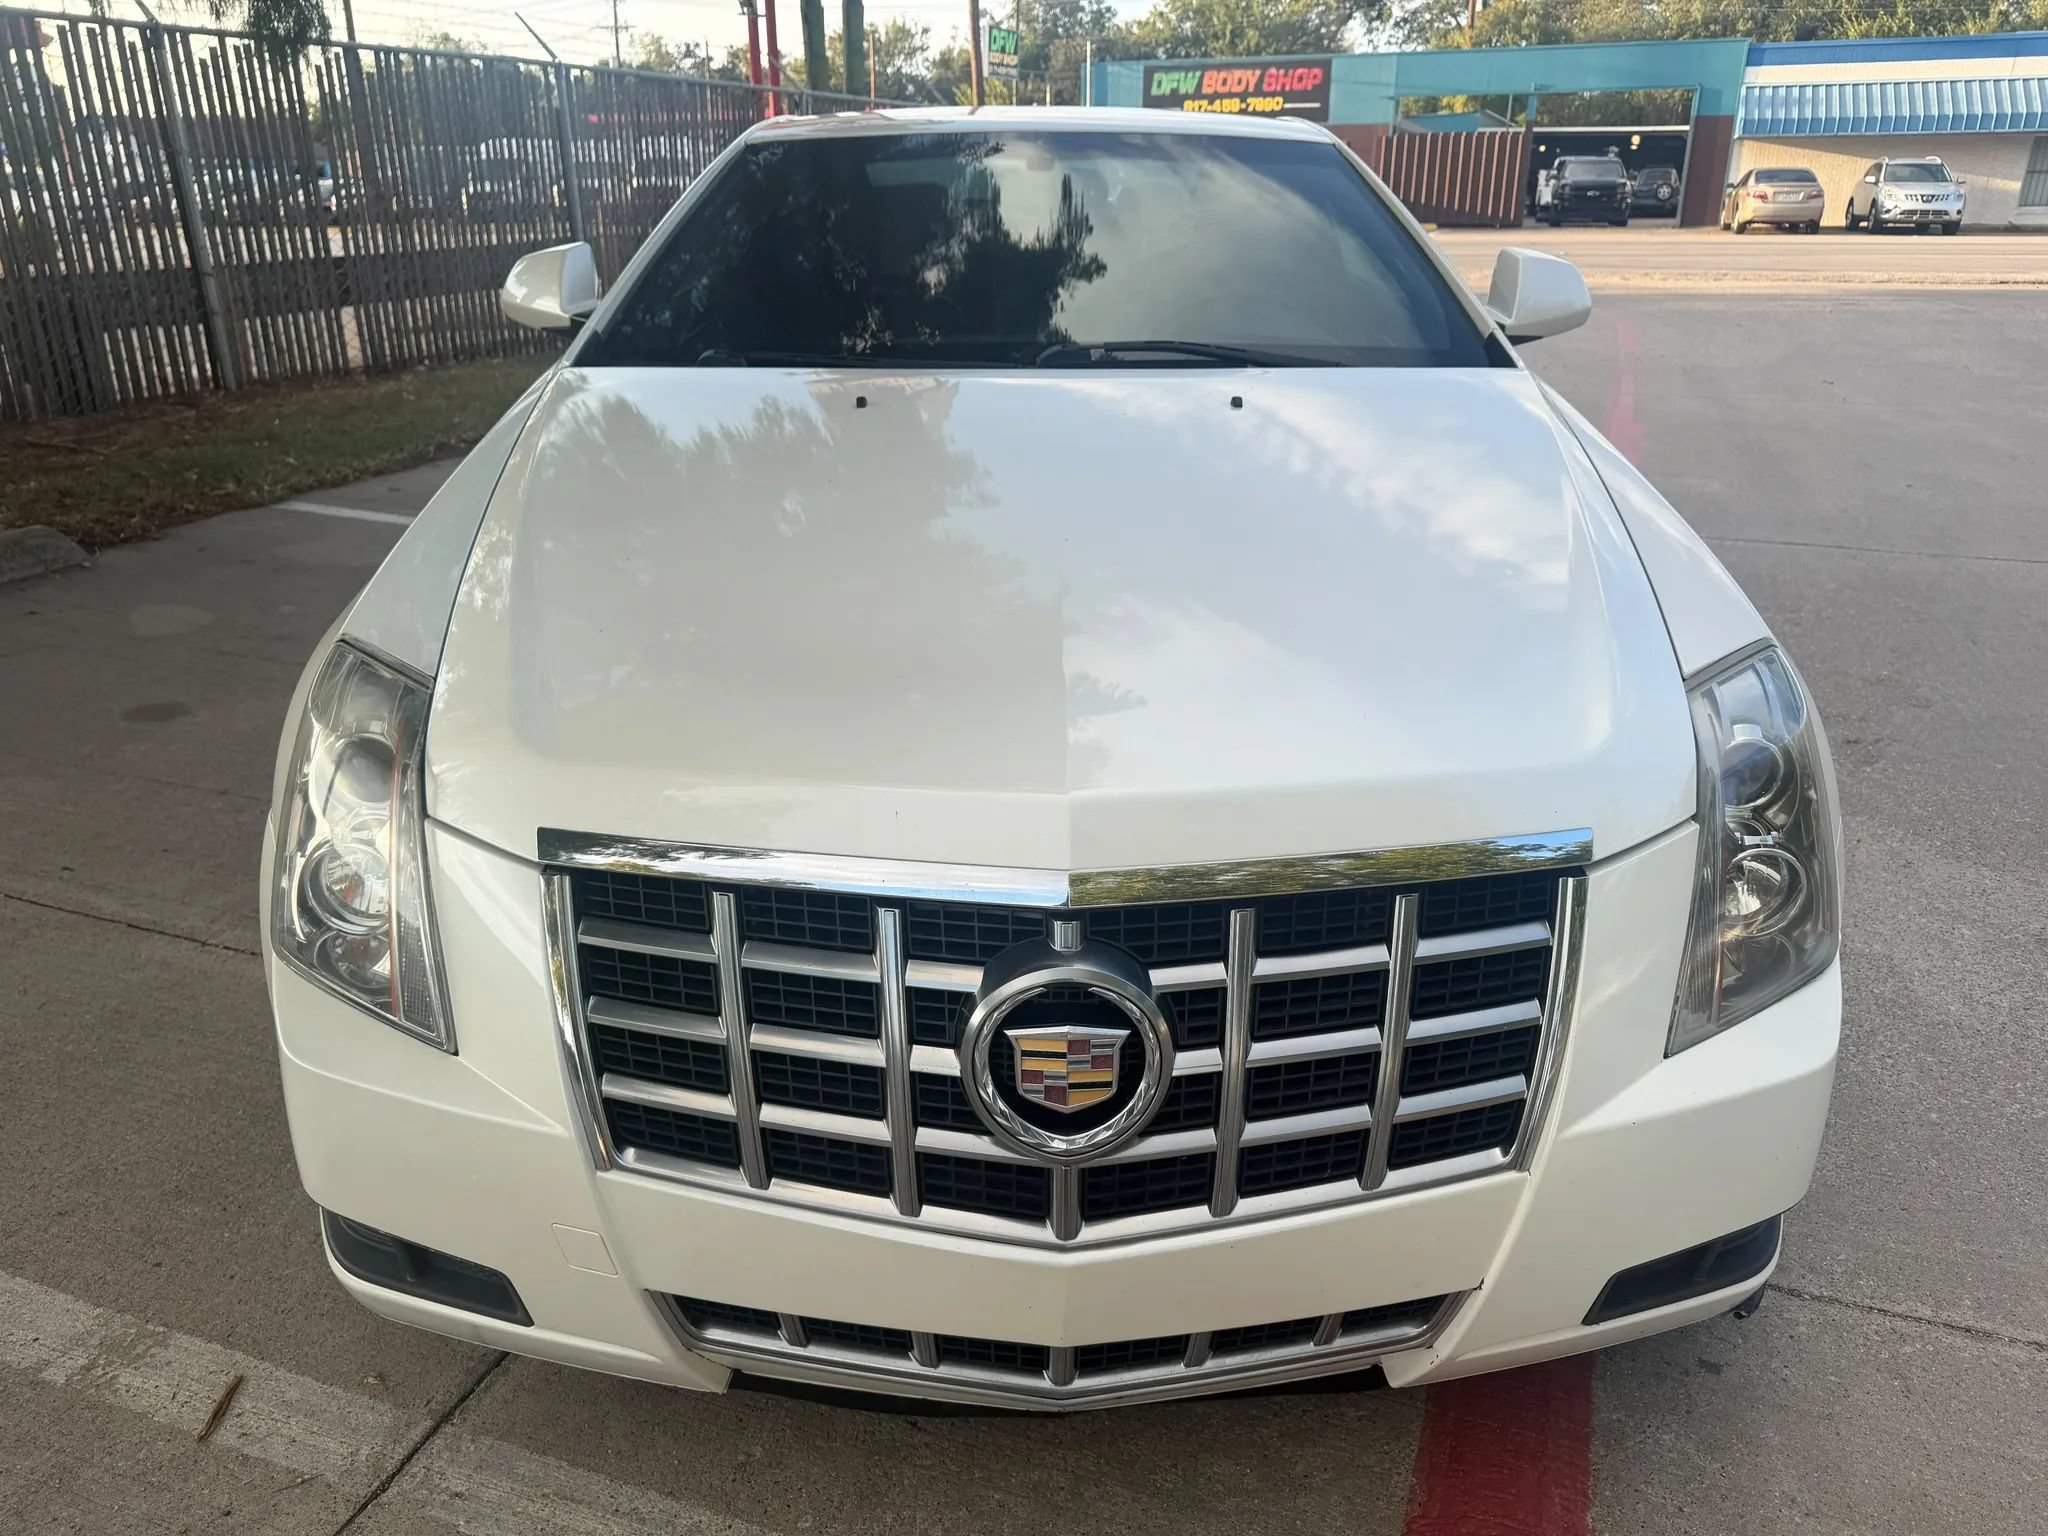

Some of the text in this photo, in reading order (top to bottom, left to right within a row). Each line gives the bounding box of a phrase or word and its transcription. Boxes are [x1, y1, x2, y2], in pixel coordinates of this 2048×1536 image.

[991, 28, 1017, 53] DFW
[1151, 67, 1323, 96] DFW BODY SHOP
